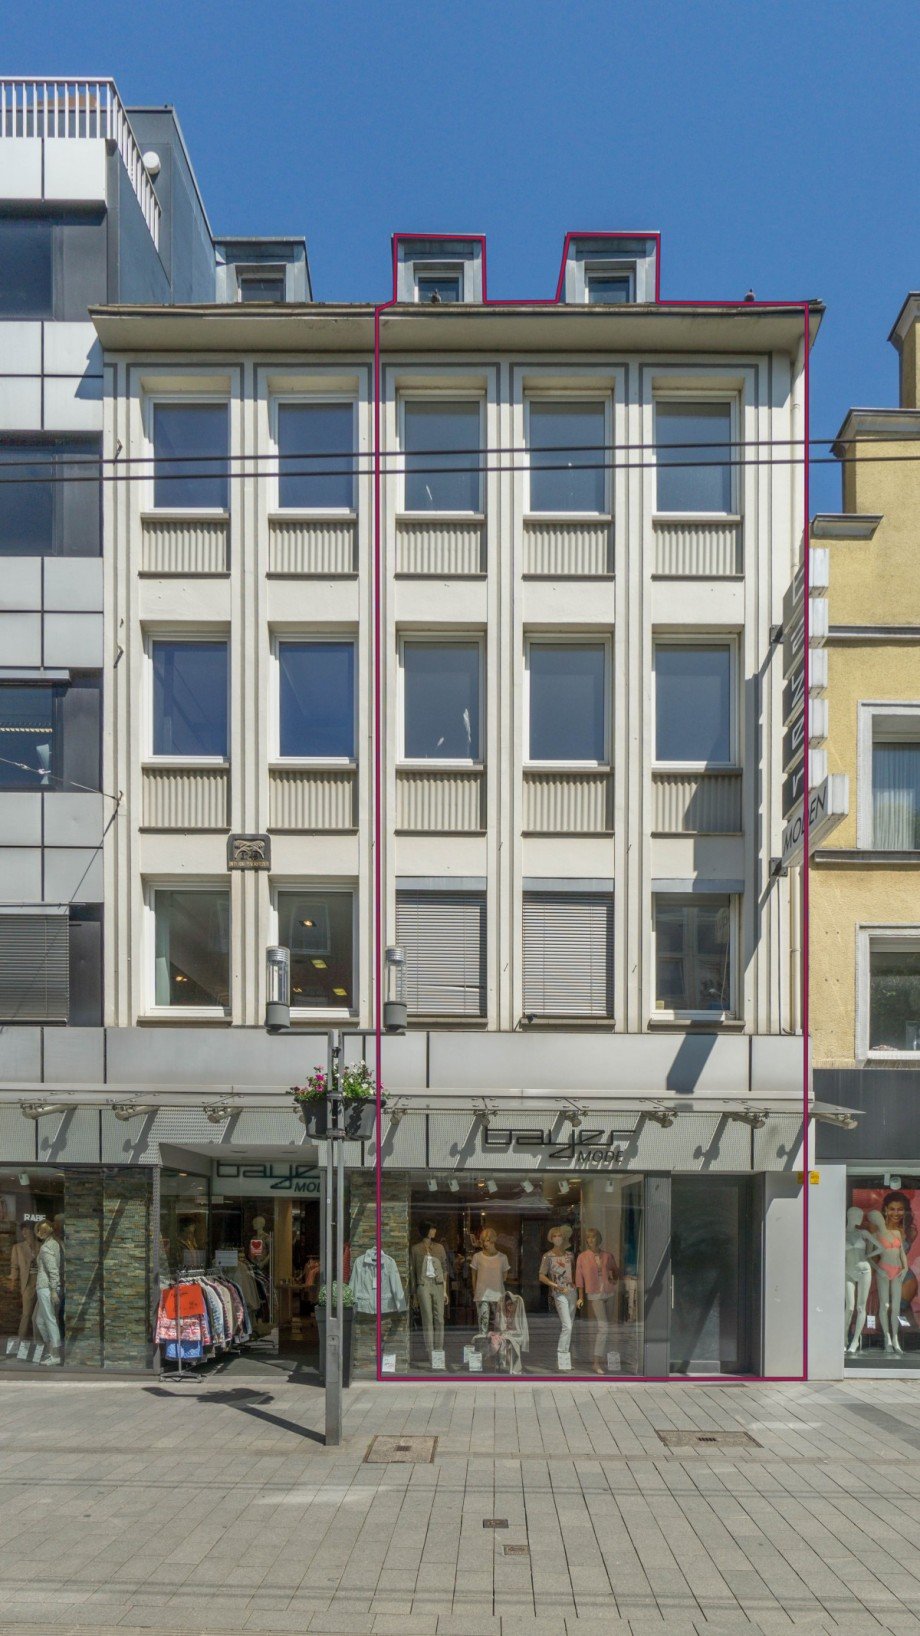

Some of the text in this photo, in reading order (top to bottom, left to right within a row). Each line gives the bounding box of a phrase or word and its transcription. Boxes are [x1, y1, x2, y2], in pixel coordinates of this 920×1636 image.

[485, 1127, 636, 1158] bayer
[577, 1150, 623, 1163] MODE
[217, 1160, 320, 1190] baye
